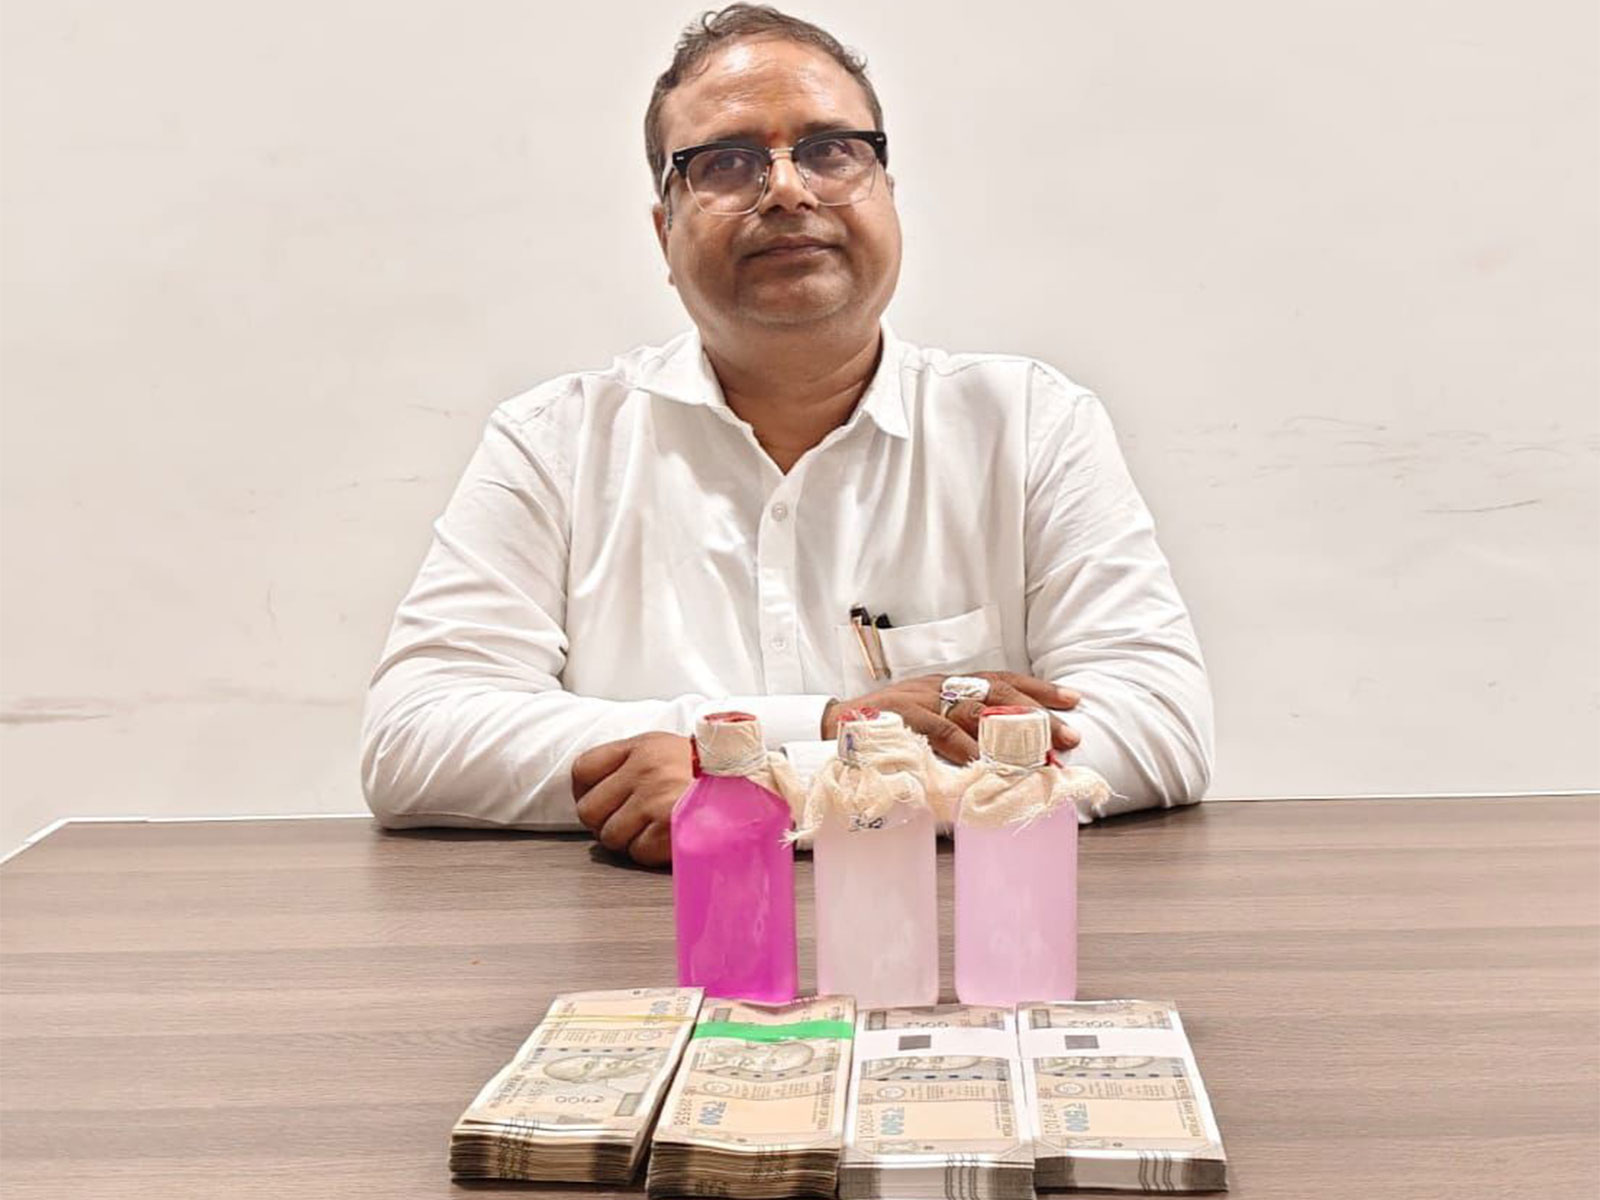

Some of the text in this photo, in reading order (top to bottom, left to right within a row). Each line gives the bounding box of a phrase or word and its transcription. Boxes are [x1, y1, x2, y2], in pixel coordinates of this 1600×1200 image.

[698, 1101, 727, 1126] ₹500
[880, 1107, 904, 1135] ₹500
[1064, 1102, 1090, 1132] ₹500
